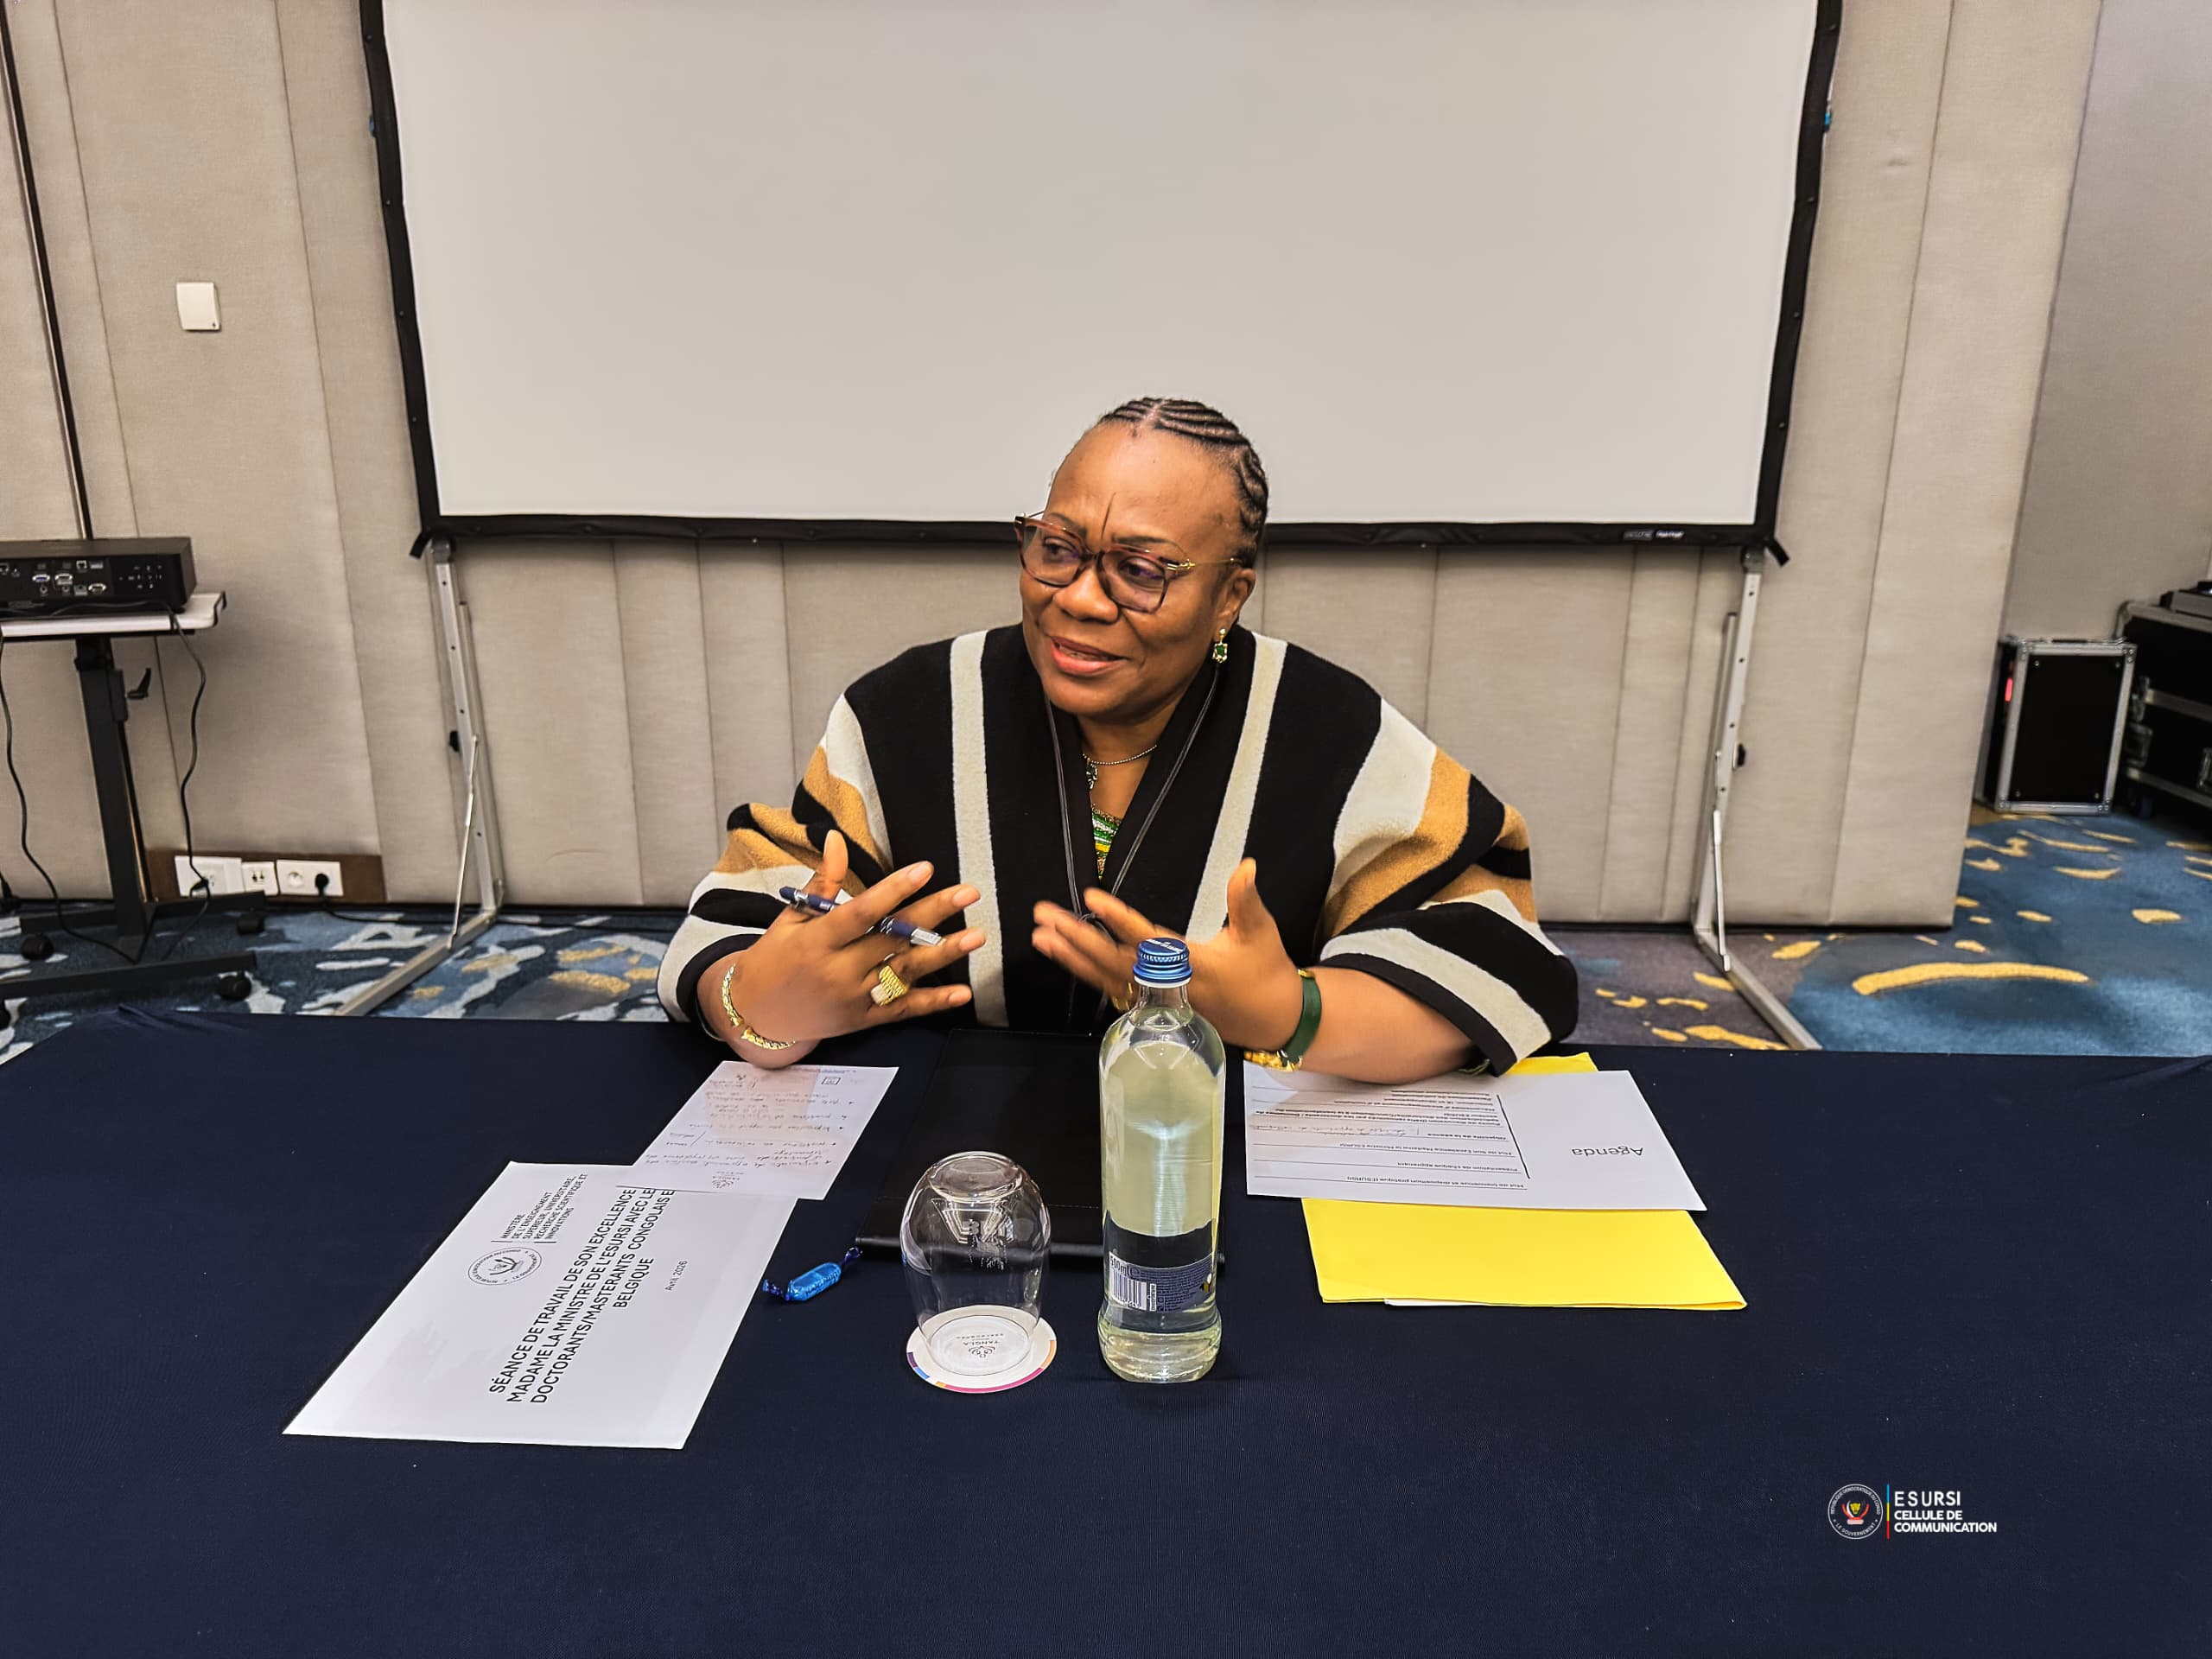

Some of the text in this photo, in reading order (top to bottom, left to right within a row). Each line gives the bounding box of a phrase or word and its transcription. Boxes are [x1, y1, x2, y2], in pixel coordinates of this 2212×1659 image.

[1572, 1146, 1643, 1157] Agenda
[639, 1187, 658, 1199] LE
[624, 1200, 648, 1224] AVEC
[488, 1189, 637, 1393] SÉANCE DE TRAVAIL DE SON EXCELLENCE
[585, 1267, 607, 1281] DE
[612, 1258, 654, 1307] BELGIQUE
[530, 1253, 635, 1403] DOCTORANTS/MASTERANTS
[627, 1197, 671, 1249] CONGOLAIS
[552, 1281, 596, 1332] MINISTRE
[541, 1333, 564, 1347] LA
[505, 1349, 554, 1402] MADAME
